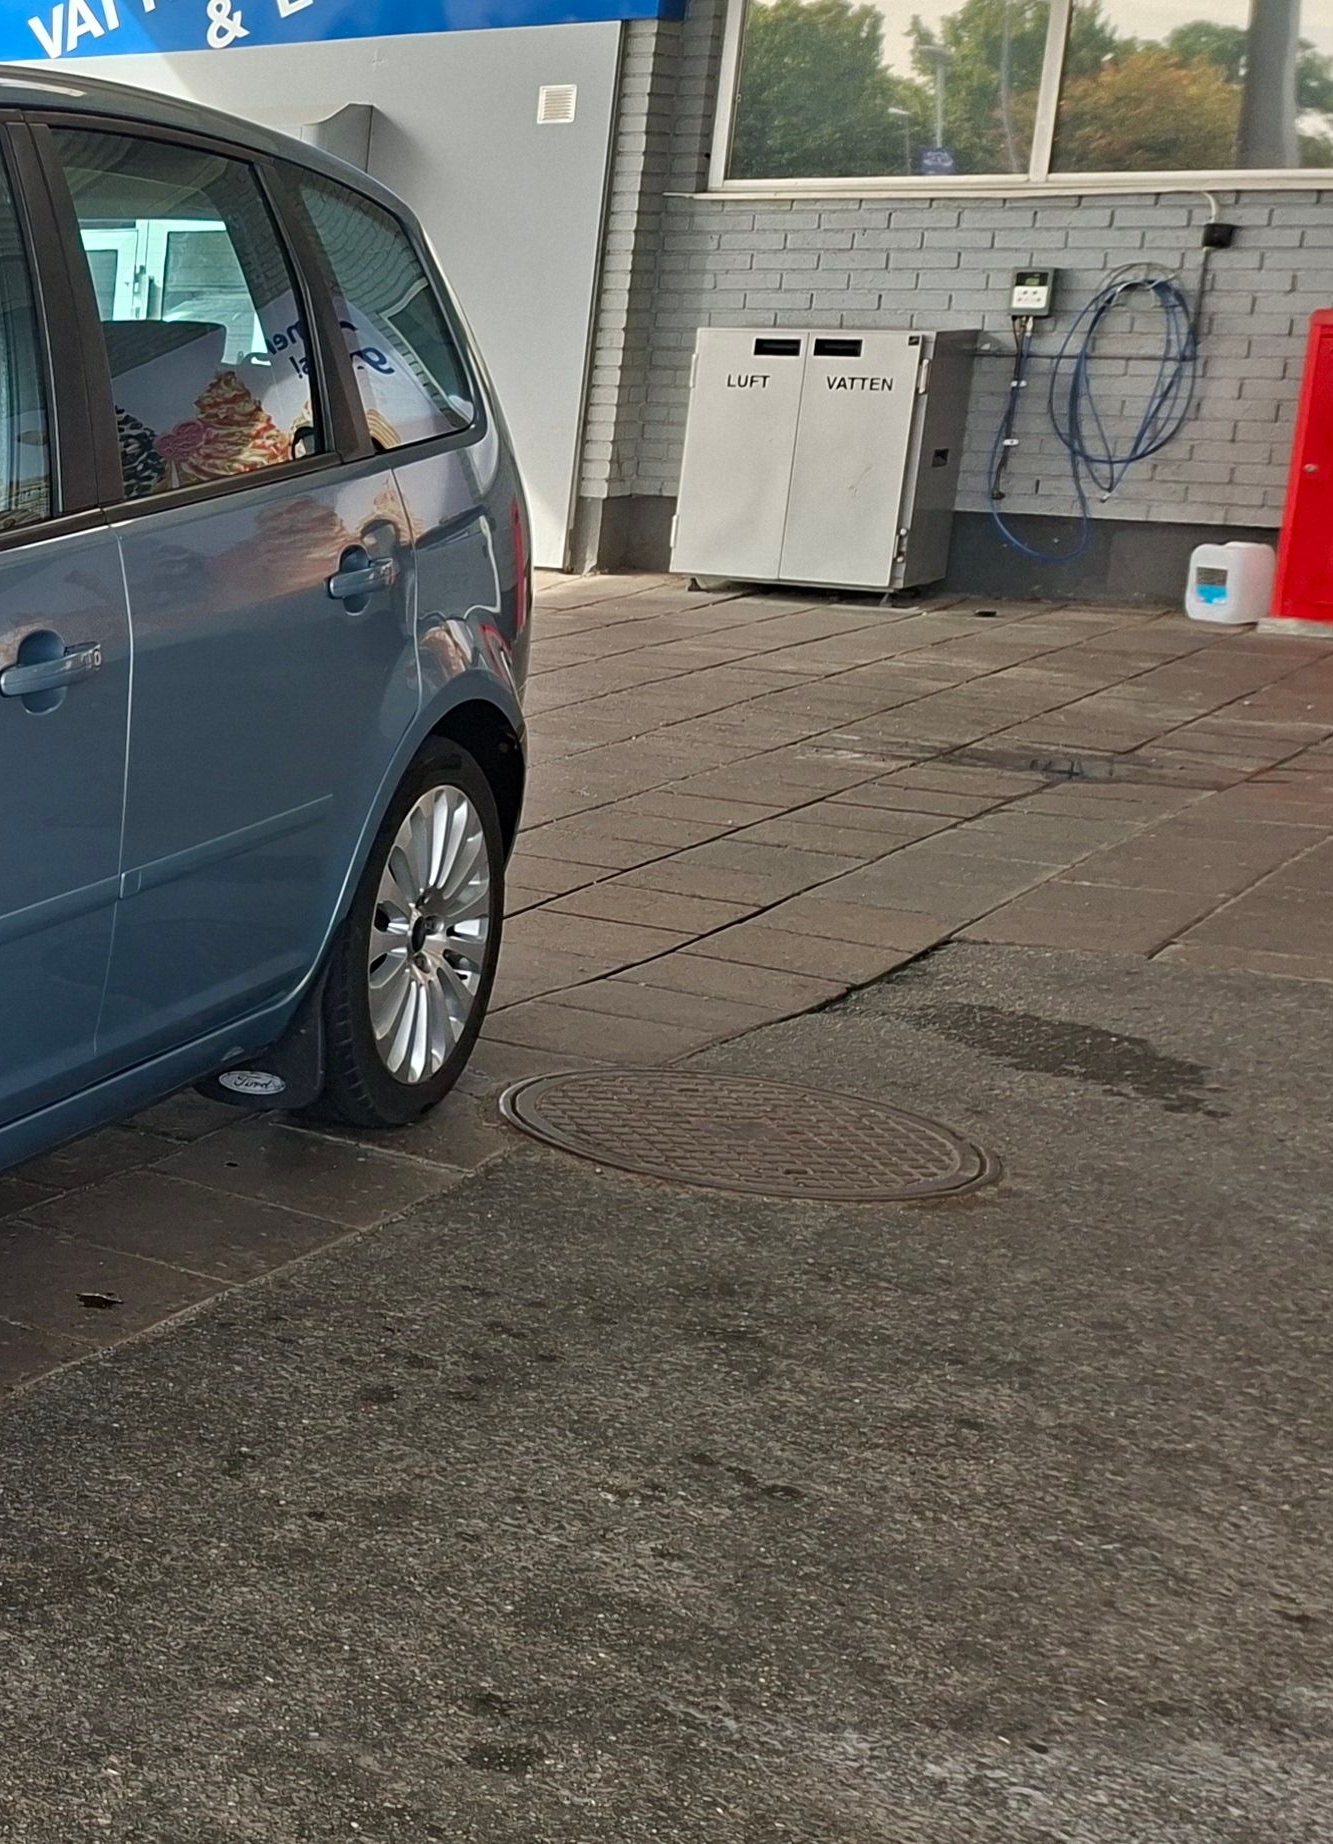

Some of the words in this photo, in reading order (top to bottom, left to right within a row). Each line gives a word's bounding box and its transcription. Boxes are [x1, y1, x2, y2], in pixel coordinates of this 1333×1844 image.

[727, 374, 770, 388] LUFT
[826, 376, 894, 391] VATTEN
[234, 1075, 273, 1090] Ford
